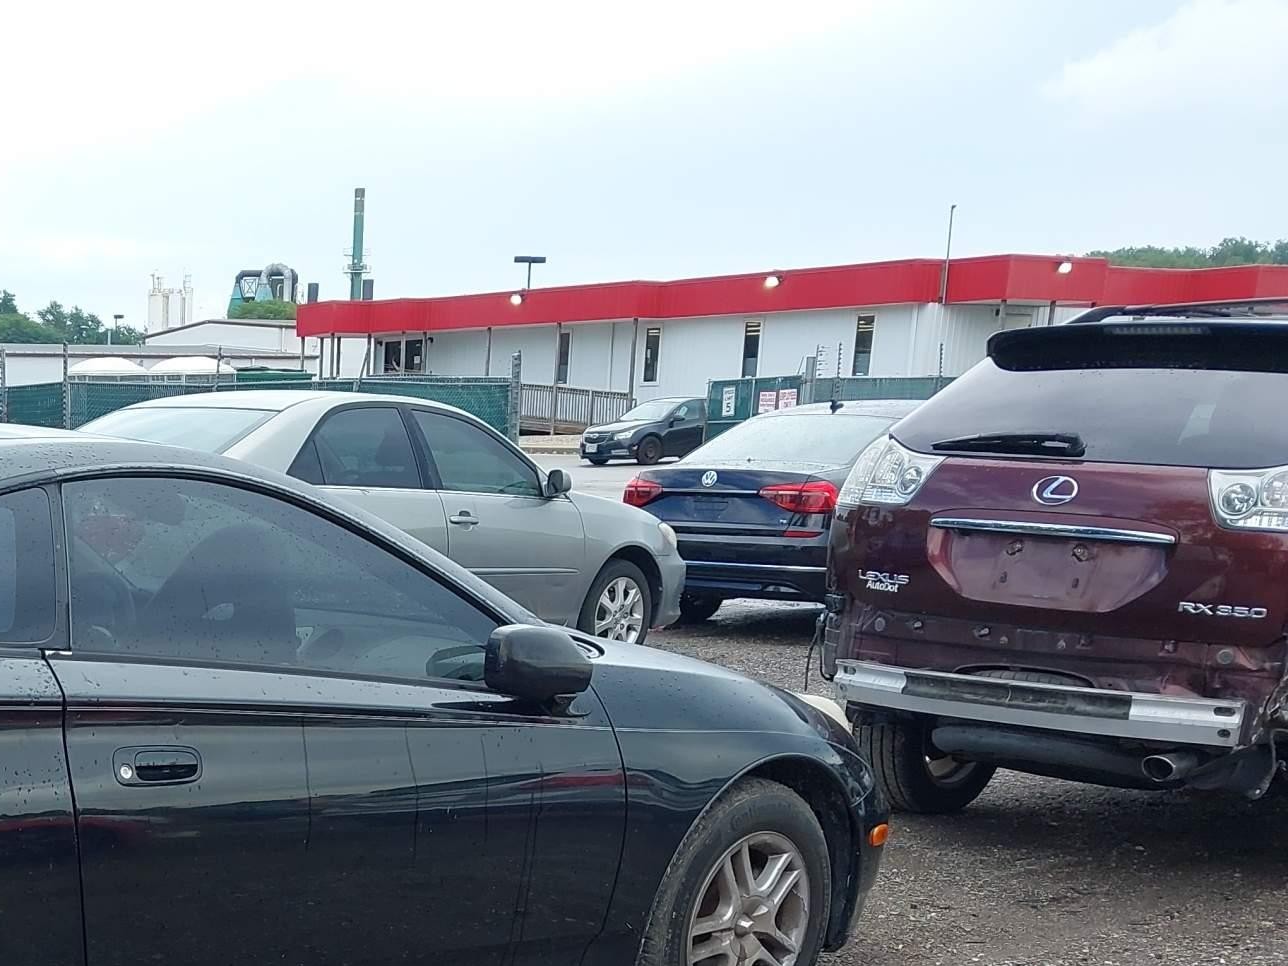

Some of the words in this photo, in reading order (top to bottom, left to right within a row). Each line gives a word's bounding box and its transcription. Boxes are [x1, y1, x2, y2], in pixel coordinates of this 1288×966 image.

[725, 402, 732, 413] 5
[858, 569, 910, 584] LEXUS
[1178, 601, 1214, 615] RX
[1216, 605, 1268, 618] 350
